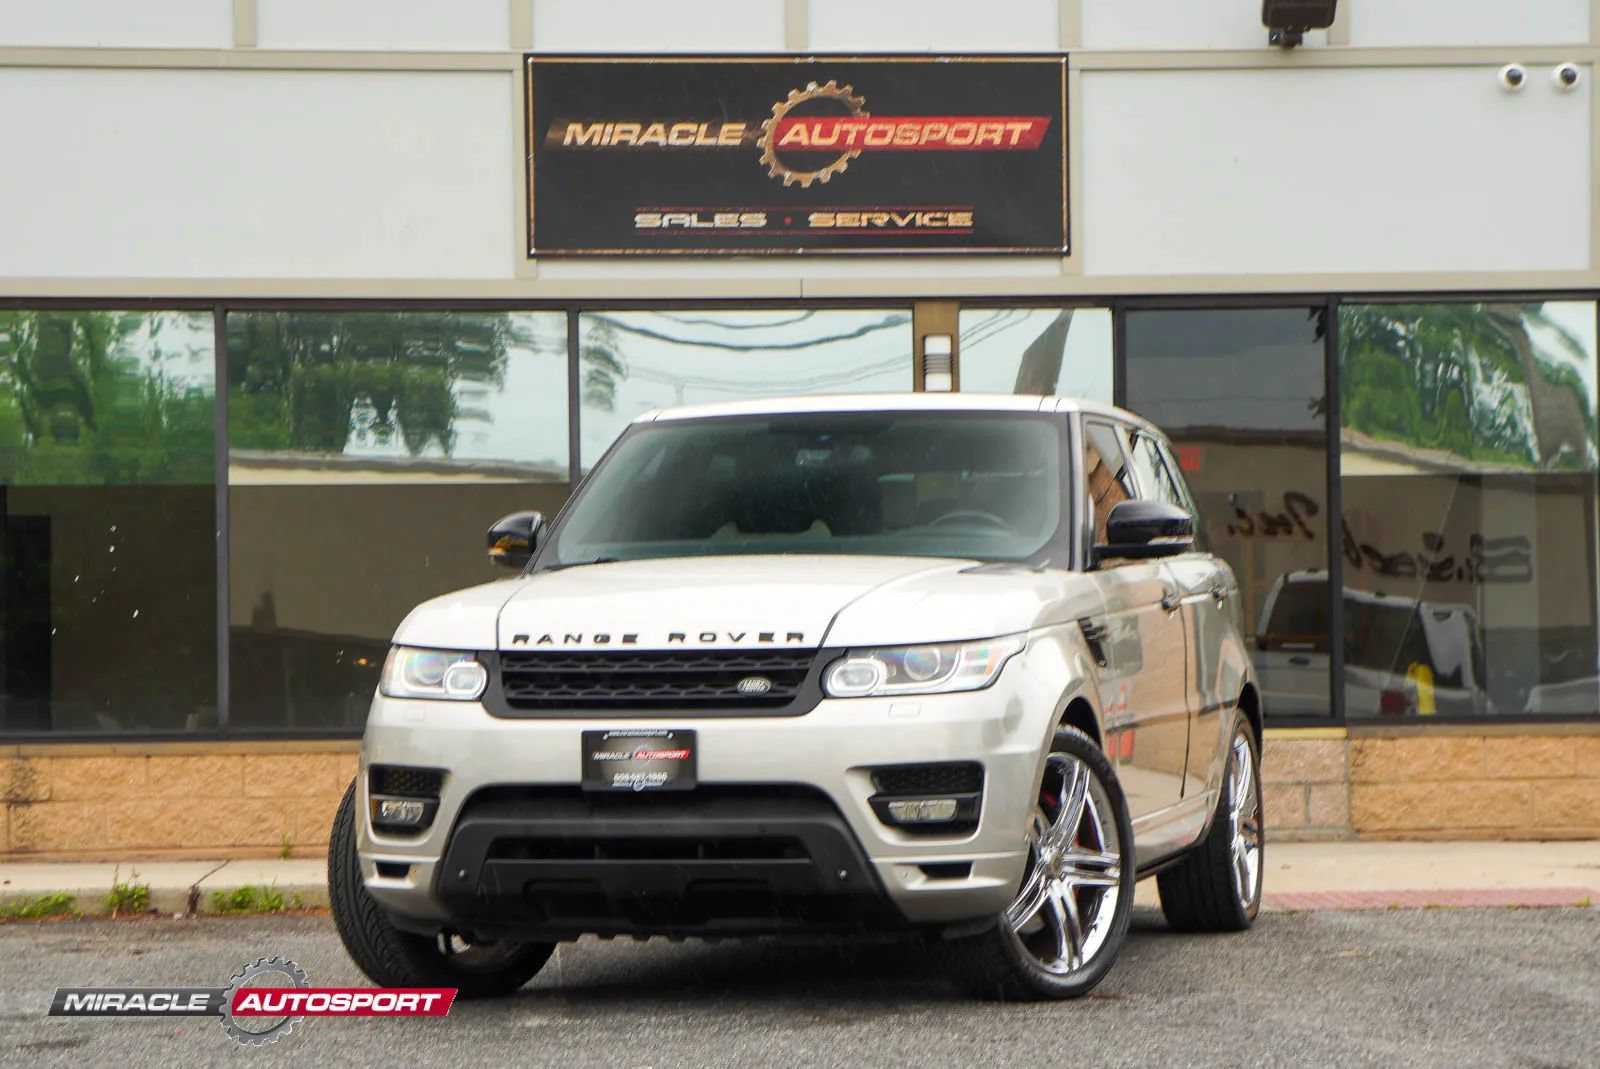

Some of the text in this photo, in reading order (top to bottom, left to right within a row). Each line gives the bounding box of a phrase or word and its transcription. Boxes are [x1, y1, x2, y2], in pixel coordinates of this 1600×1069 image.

[563, 120, 1034, 148] MIRACLE AUTOSPORT
[634, 211, 974, 228] SALES SERVICE
[512, 631, 806, 645] RANGE ROVER
